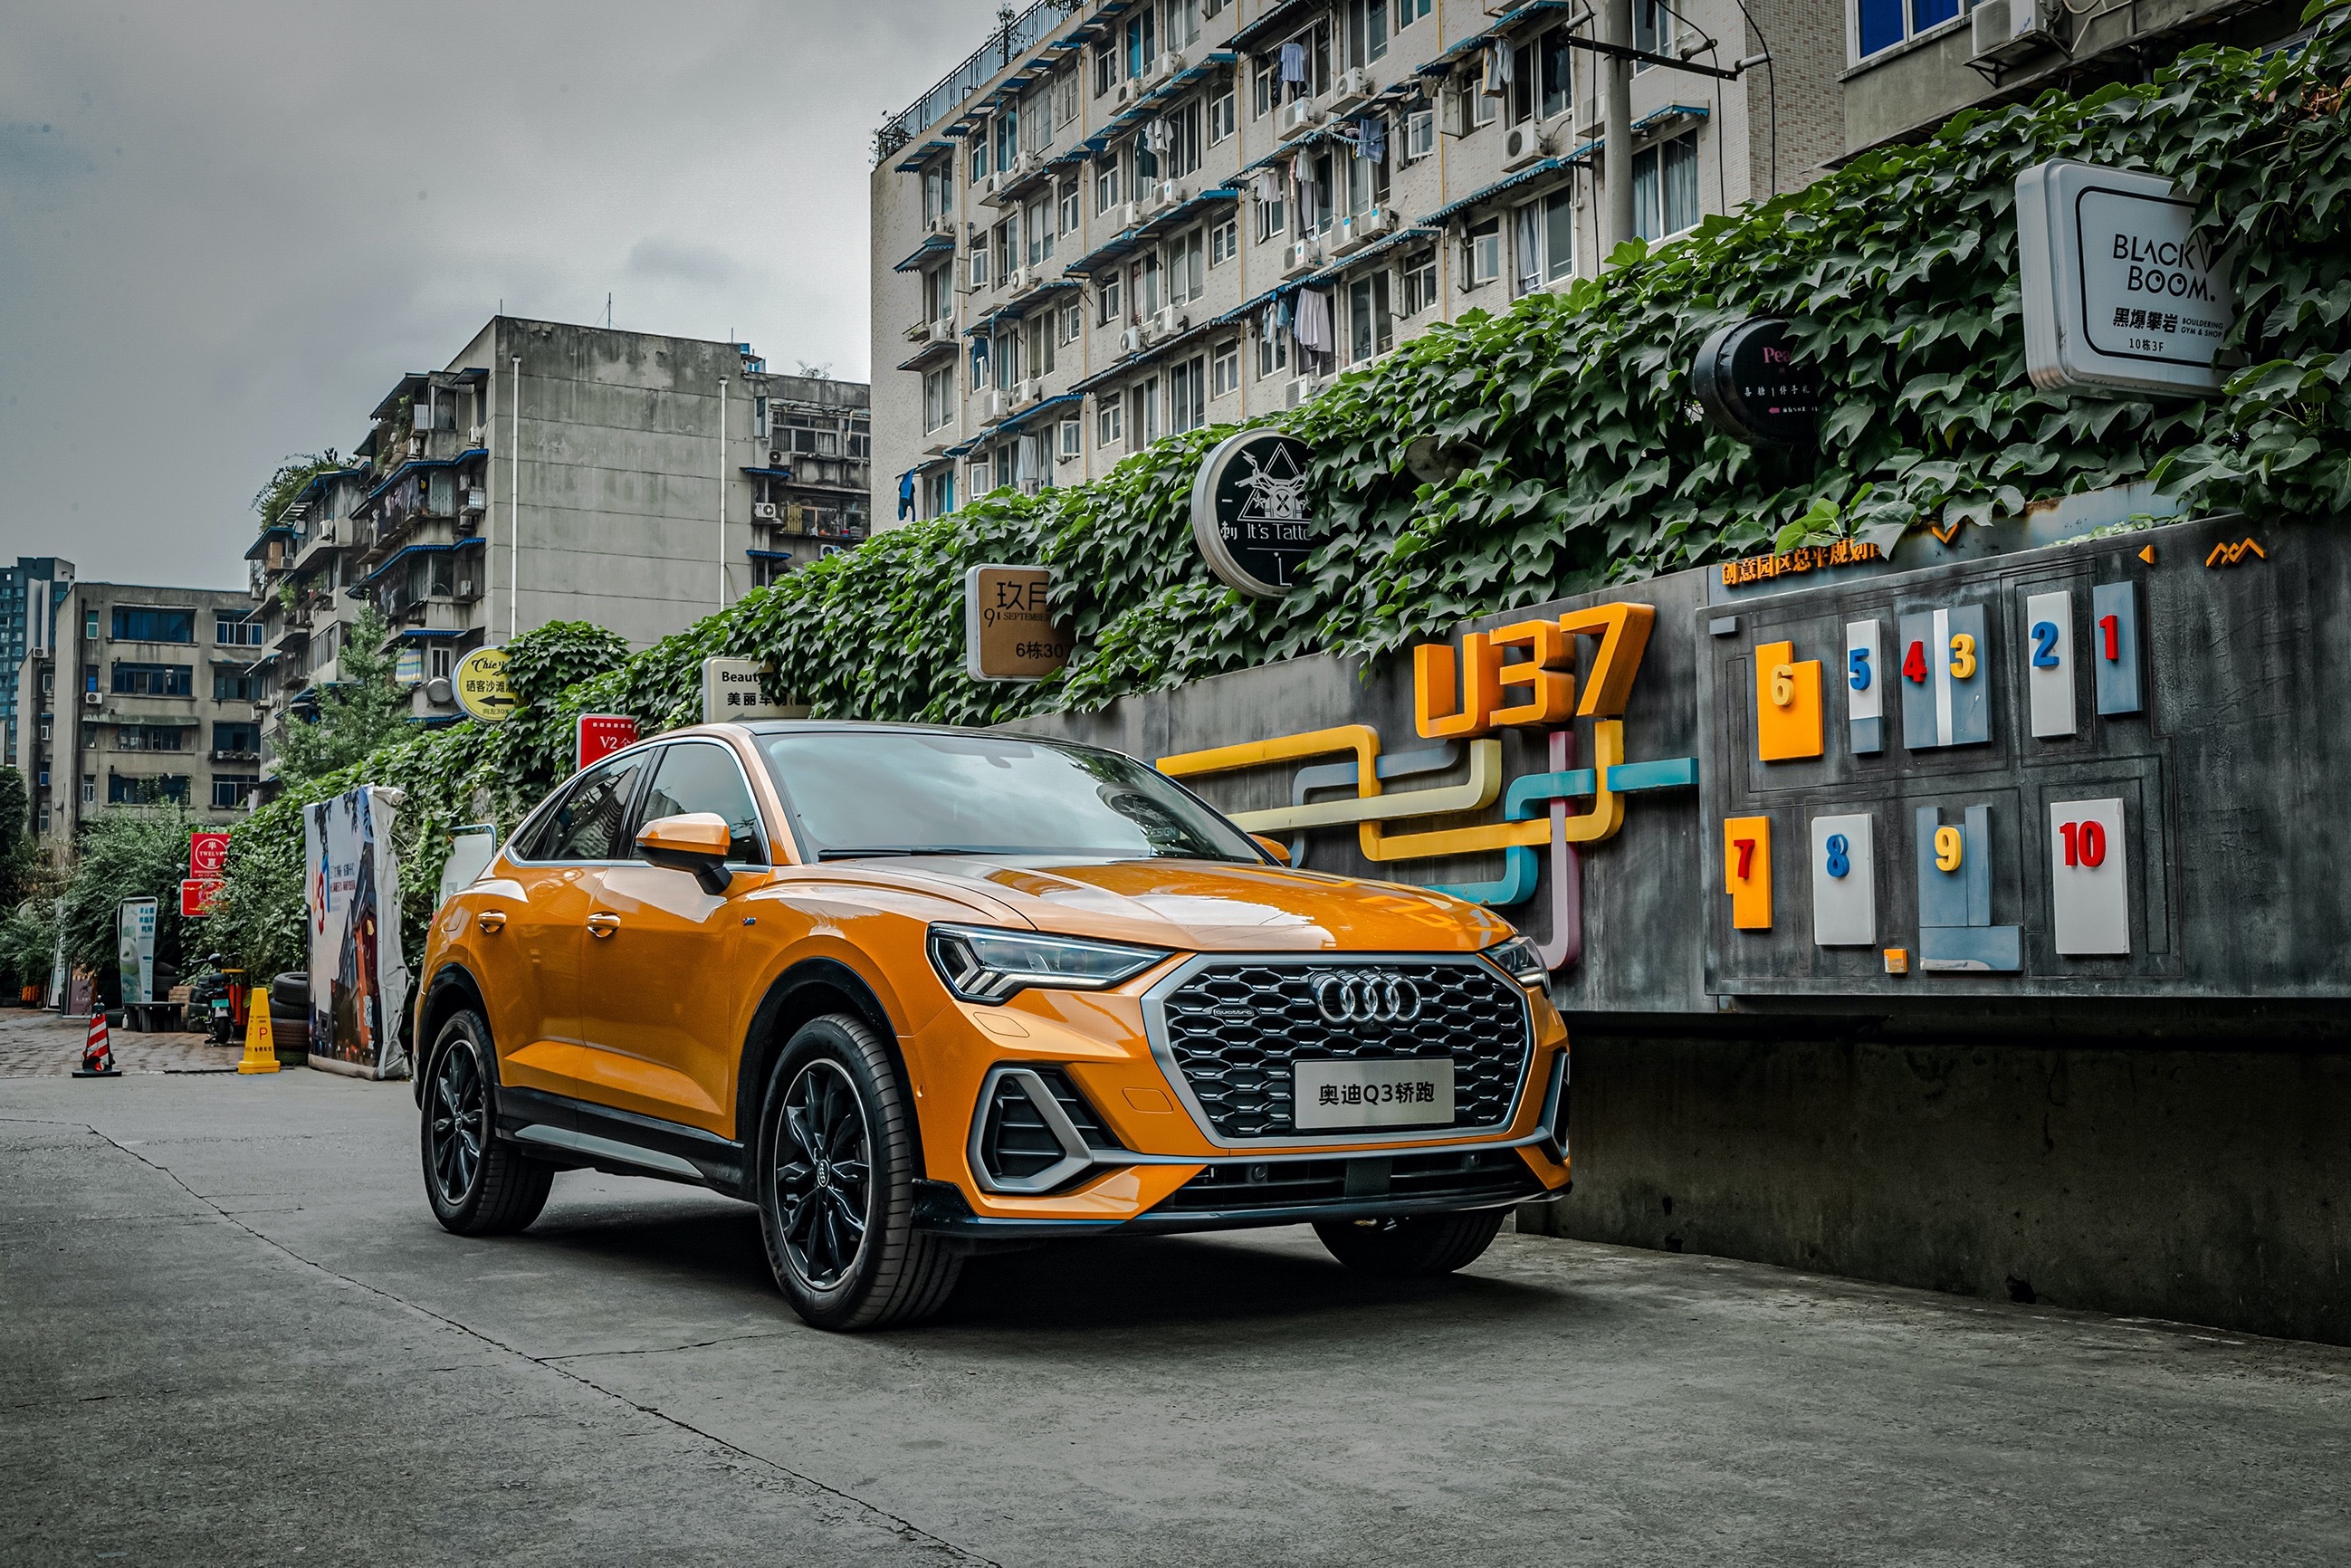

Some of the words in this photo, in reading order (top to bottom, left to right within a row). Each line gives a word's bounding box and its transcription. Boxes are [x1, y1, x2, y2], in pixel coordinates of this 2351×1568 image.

[2113, 234, 2196, 271] BLACK
[2127, 265, 2216, 302] BOOM.
[2113, 307, 2178, 334] 黑爆攀岩
[2181, 326, 2196, 335] GYM
[2204, 330, 2222, 339] SHOP
[2182, 317, 2224, 330] BOULDERING
[2129, 338, 2164, 352] 10栋3F
[1247, 522, 1269, 540] It's
[1950, 633, 1976, 679] 3
[2031, 621, 2060, 668] 2
[2098, 614, 2119, 661] 1
[1414, 602, 1656, 739] U37
[1849, 647, 1871, 691] 5
[1902, 641, 1928, 684] 4
[727, 692, 788, 706] 美丽车
[1771, 664, 1794, 706] 6
[599, 735, 618, 750] V2
[1734, 838, 1755, 880] 7
[1826, 833, 1850, 878] 8
[1935, 826, 1963, 872] 9
[2059, 820, 2107, 867] 10
[259, 1027, 268, 1040] P
[1318, 1081, 1436, 1105] 奥迪Q3轿跑
